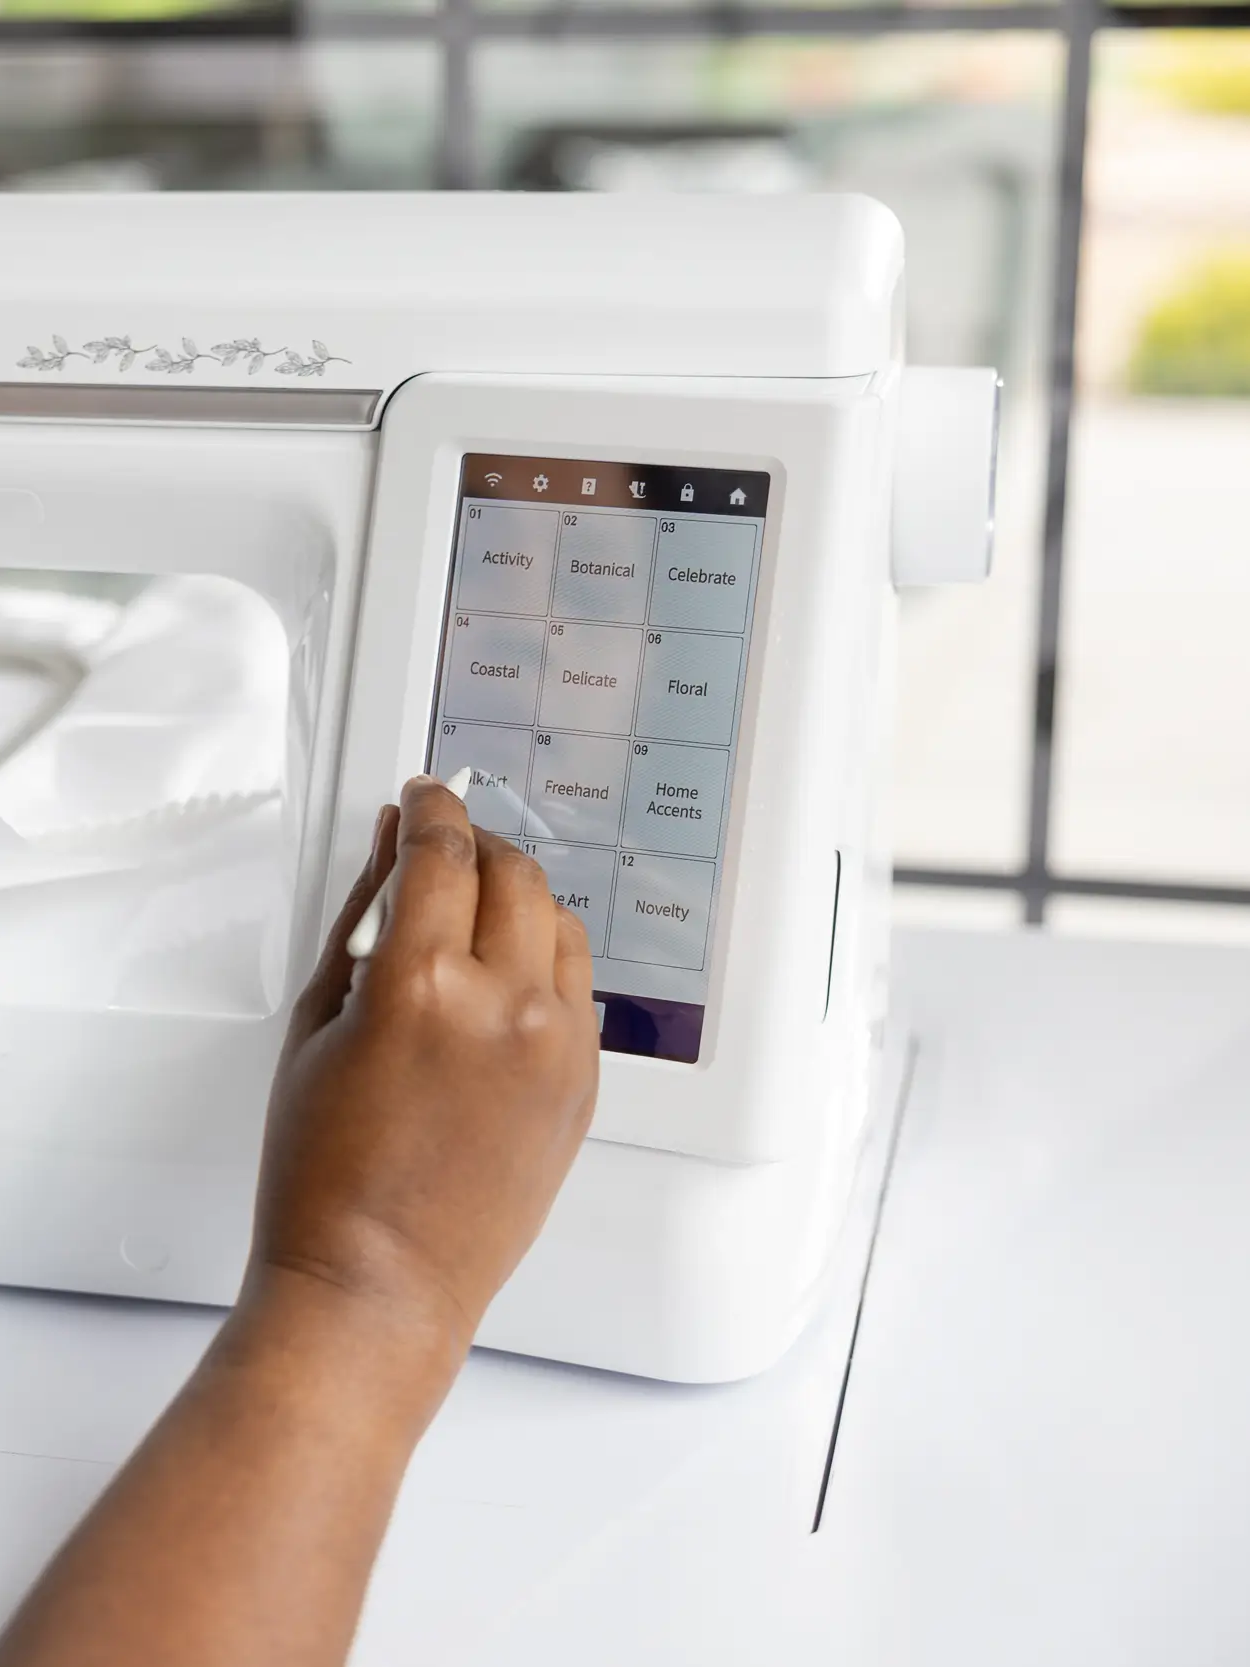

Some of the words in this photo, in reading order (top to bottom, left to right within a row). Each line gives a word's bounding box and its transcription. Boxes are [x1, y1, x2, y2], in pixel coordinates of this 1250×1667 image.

[469, 508, 482, 519] 01
[564, 515, 577, 526] 02
[661, 522, 675, 533] 03
[482, 551, 534, 569] Activity
[570, 560, 635, 578] Botanical
[668, 567, 736, 586] Celebrate
[456, 616, 469, 627] 04
[550, 624, 564, 636] 05
[648, 633, 661, 644] 06
[470, 662, 520, 679] Coastal
[562, 670, 617, 688] Delicate
[668, 680, 707, 697] Floral
[443, 725, 456, 736] 07
[537, 734, 551, 746] 08
[634, 744, 648, 756] 09
[486, 774, 508, 789] Art
[545, 780, 609, 800] Freehand
[656, 782, 699, 800] Home
[646, 801, 702, 820] Accents
[525, 844, 536, 855] 11
[621, 855, 634, 867] 12
[567, 893, 589, 908] Art
[635, 899, 690, 921] Novelty
